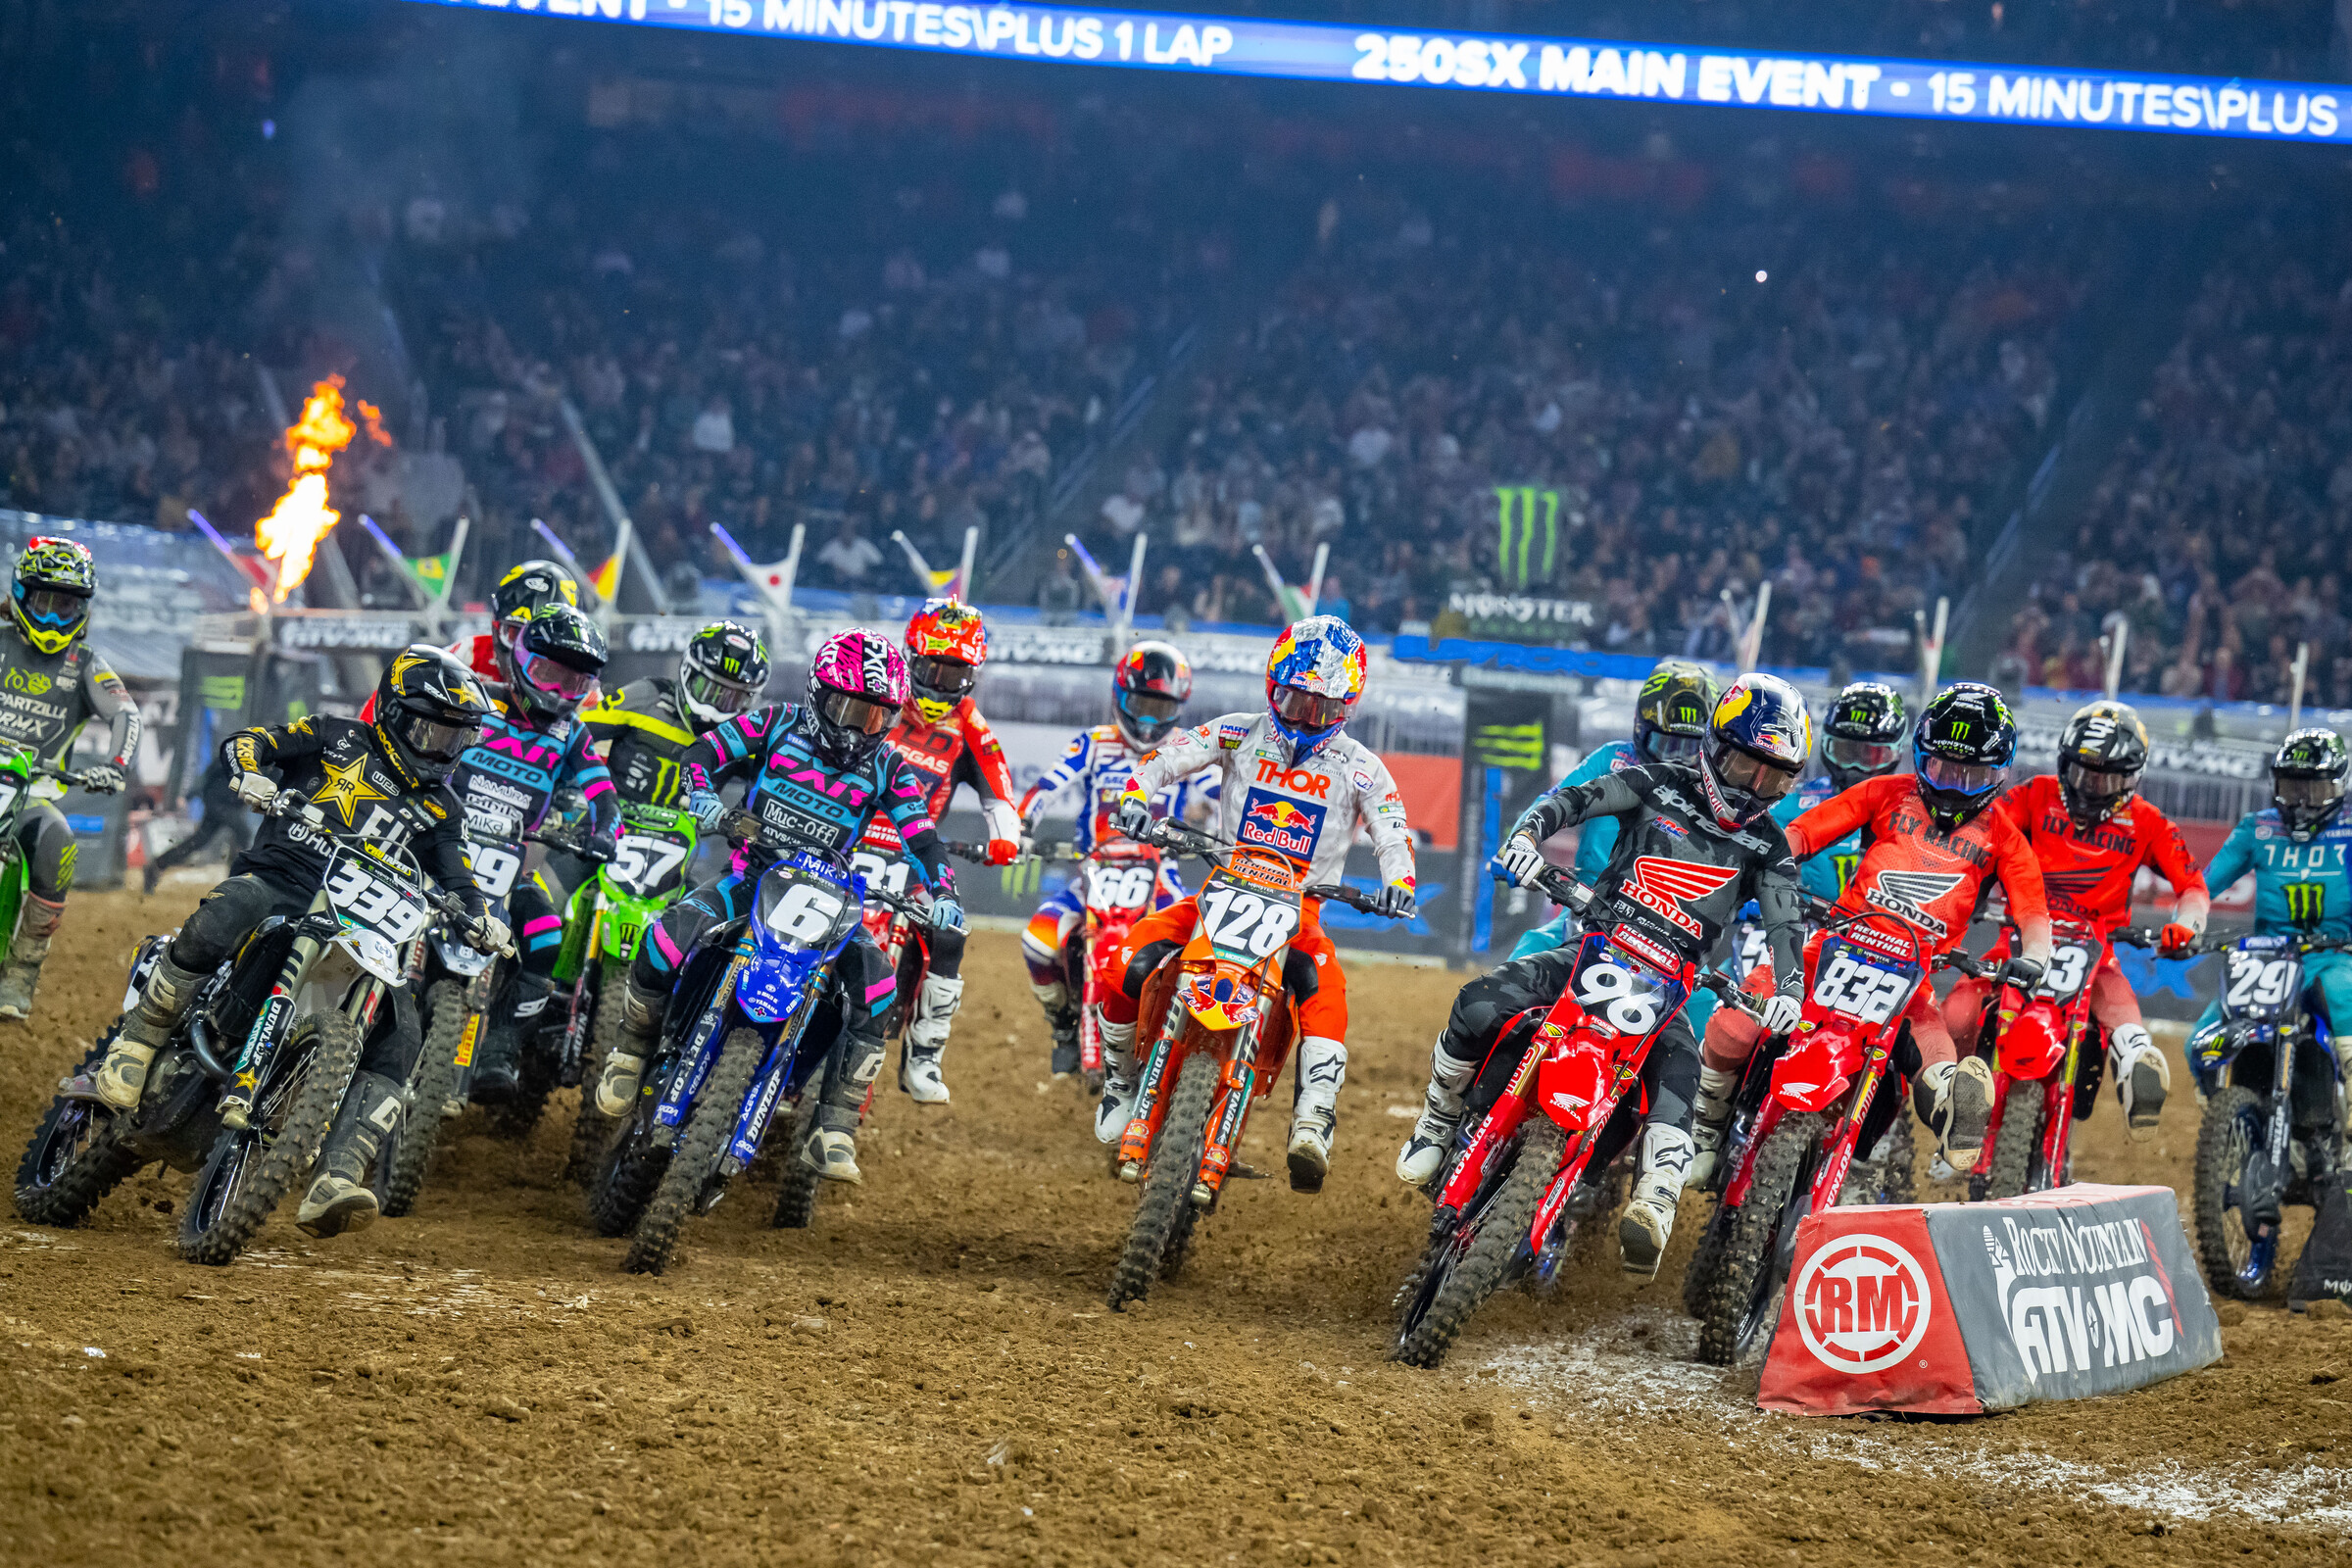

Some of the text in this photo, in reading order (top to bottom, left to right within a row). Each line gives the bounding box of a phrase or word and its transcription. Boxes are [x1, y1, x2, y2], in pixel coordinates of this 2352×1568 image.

[1114, 22, 1133, 62] 1
[1143, 24, 1234, 68] LAP
[1351, 33, 1529, 89] 250SX
[1540, 44, 1686, 99] MAIN
[1697, 54, 1882, 110] EVENT
[1928, 72, 1977, 115] 15
[0, 710, 50, 741] RMX
[1932, 738, 1977, 754] MONSTER
[470, 750, 543, 784] MOTO
[768, 743, 876, 808] FXR
[885, 740, 951, 775] ASGAS
[1319, 749, 1348, 763] Airoh
[468, 774, 533, 810] NAMURA
[772, 781, 845, 819] MOTO
[1254, 758, 1332, 800] THOR
[1244, 819, 1312, 855] Red Bull
[1650, 815, 1690, 842] HRC
[1887, 810, 1993, 869] FLY RACING
[2042, 814, 2068, 837] FLY
[606, 835, 688, 888] 57
[1233, 864, 1291, 888] RENTHAL
[2264, 844, 2347, 868] THOR
[327, 862, 424, 943] 339
[1087, 866, 1155, 910] 66
[1618, 877, 1704, 941] HONDA
[766, 883, 844, 943] 6
[1202, 888, 1298, 958] 128
[1864, 886, 1949, 939] HONDA
[1849, 931, 1909, 957] RENTHAL
[1853, 923, 1912, 950] RENTHAL
[1576, 962, 1665, 1036] 96
[1812, 956, 1911, 1025] 832
[2227, 957, 2299, 1006] 29
[755, 998, 778, 1015] YAMAHA
[456, 1012, 479, 1065] PIRELLI
[750, 1069, 781, 1144] DUNLOP
[1222, 1069, 1247, 1134] DUNLP
[1548, 1098, 1582, 1123] HONDA
[1778, 1090, 1813, 1106] HONDA
[1448, 1113, 1494, 1188] DUNLOP
[1541, 1167, 1583, 1243] DUNLOP
[1819, 1274, 1903, 1334] RM
